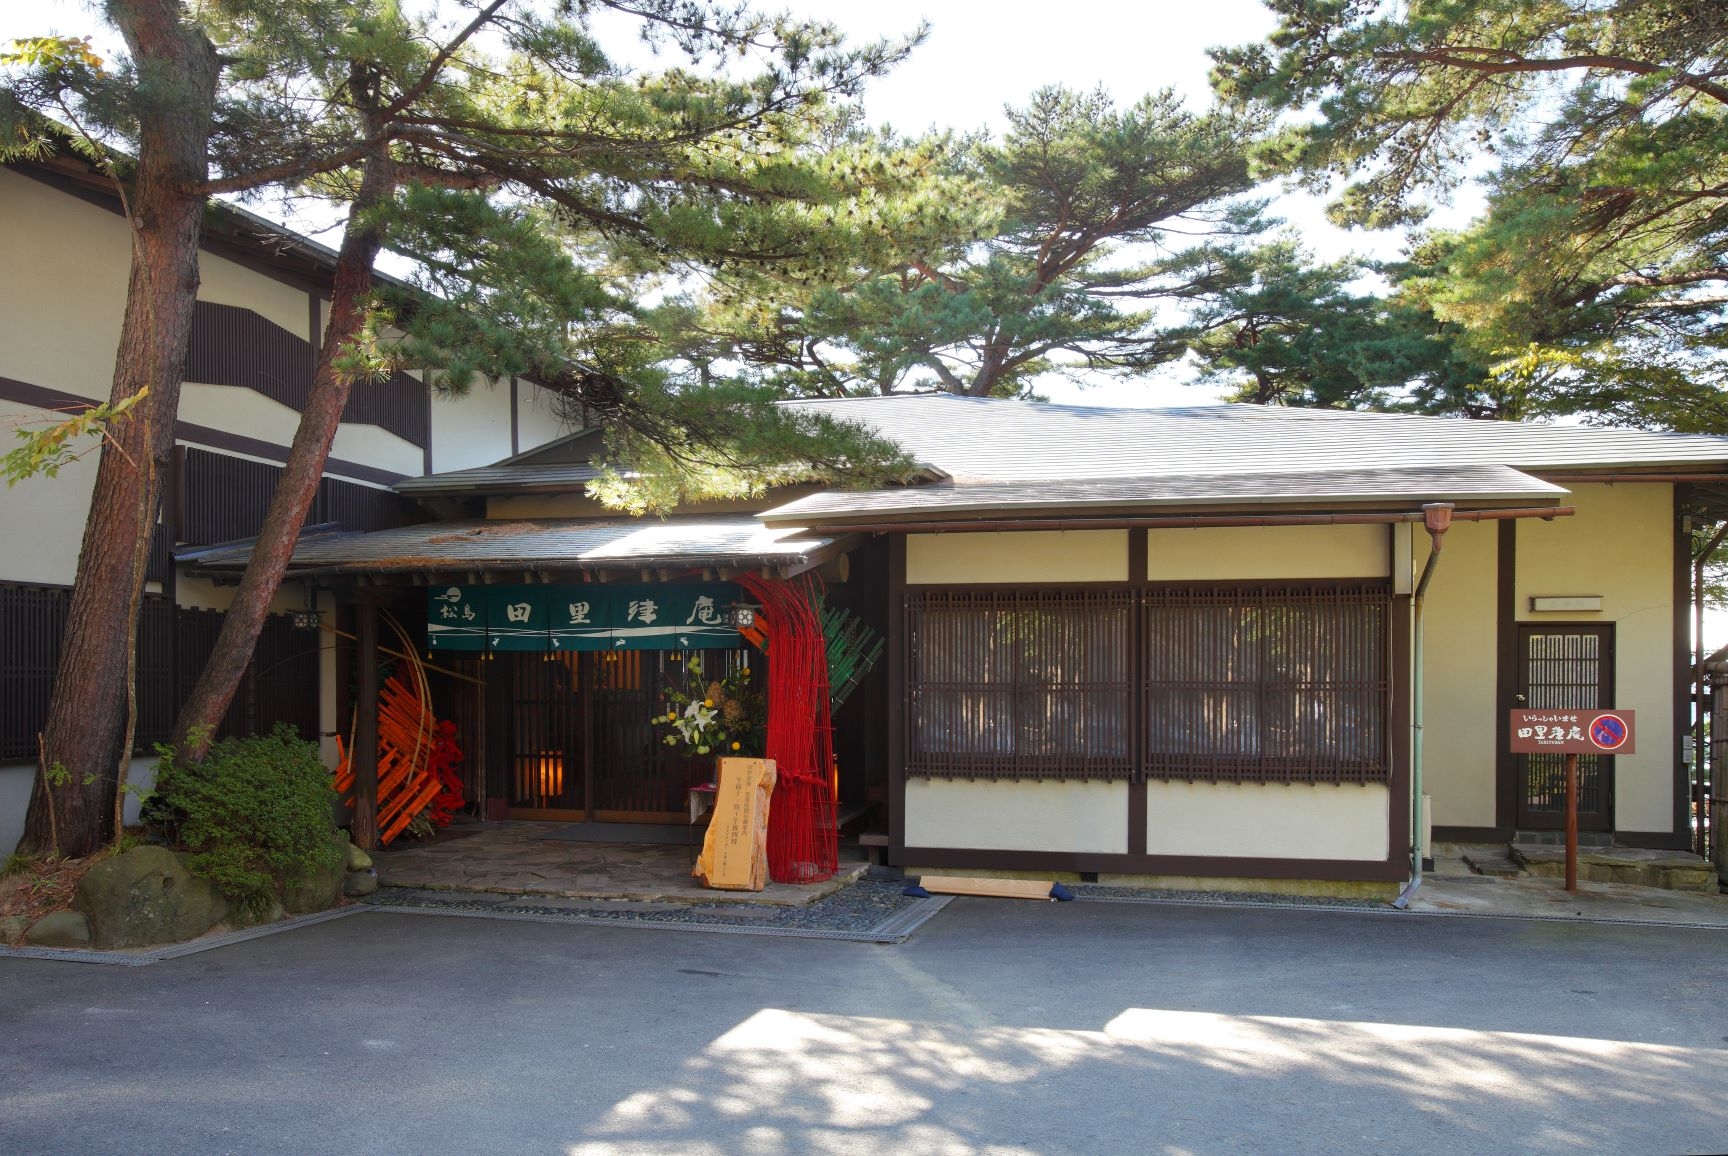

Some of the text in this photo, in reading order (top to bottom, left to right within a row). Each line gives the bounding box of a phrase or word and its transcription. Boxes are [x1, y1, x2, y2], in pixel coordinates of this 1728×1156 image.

[440, 604, 476, 621] 松島
[507, 596, 722, 625] 田里津庵
[1523, 714, 1578, 722] いらっしゃいませ
[1518, 725, 1585, 741] 田里津庵
